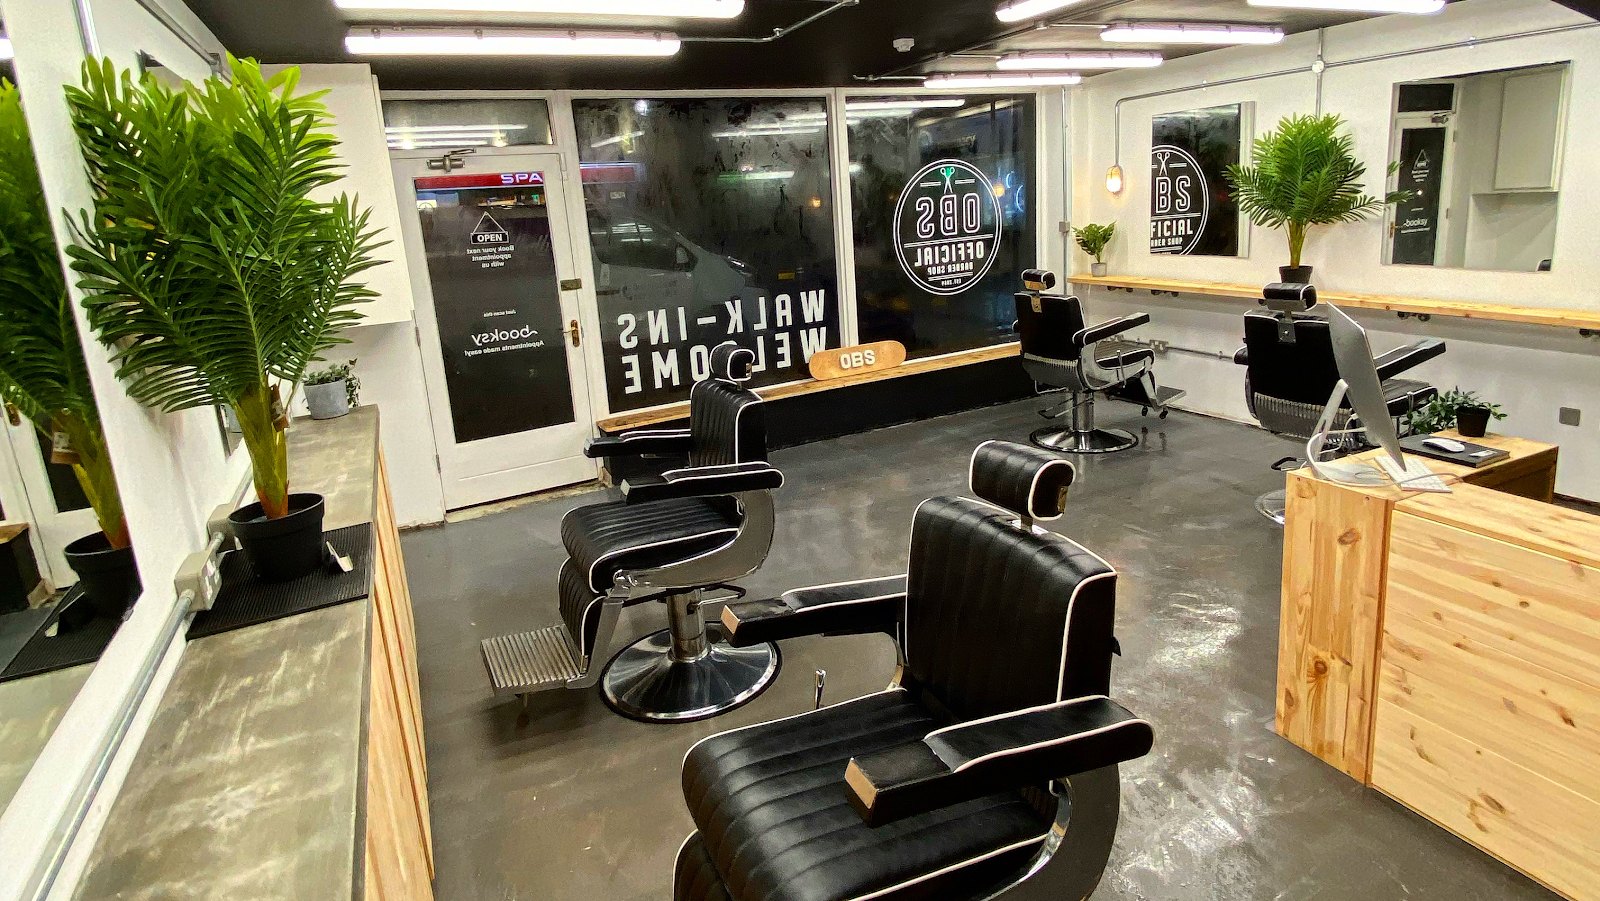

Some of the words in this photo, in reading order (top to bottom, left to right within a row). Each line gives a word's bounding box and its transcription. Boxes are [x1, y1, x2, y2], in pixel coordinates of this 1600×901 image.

[500, 172, 543, 184] SPA
[1156, 175, 1191, 214] BS
[476, 233, 503, 242] OPEN
[1150, 218, 1194, 238] FICIAL
[839, 349, 876, 370] OBS
